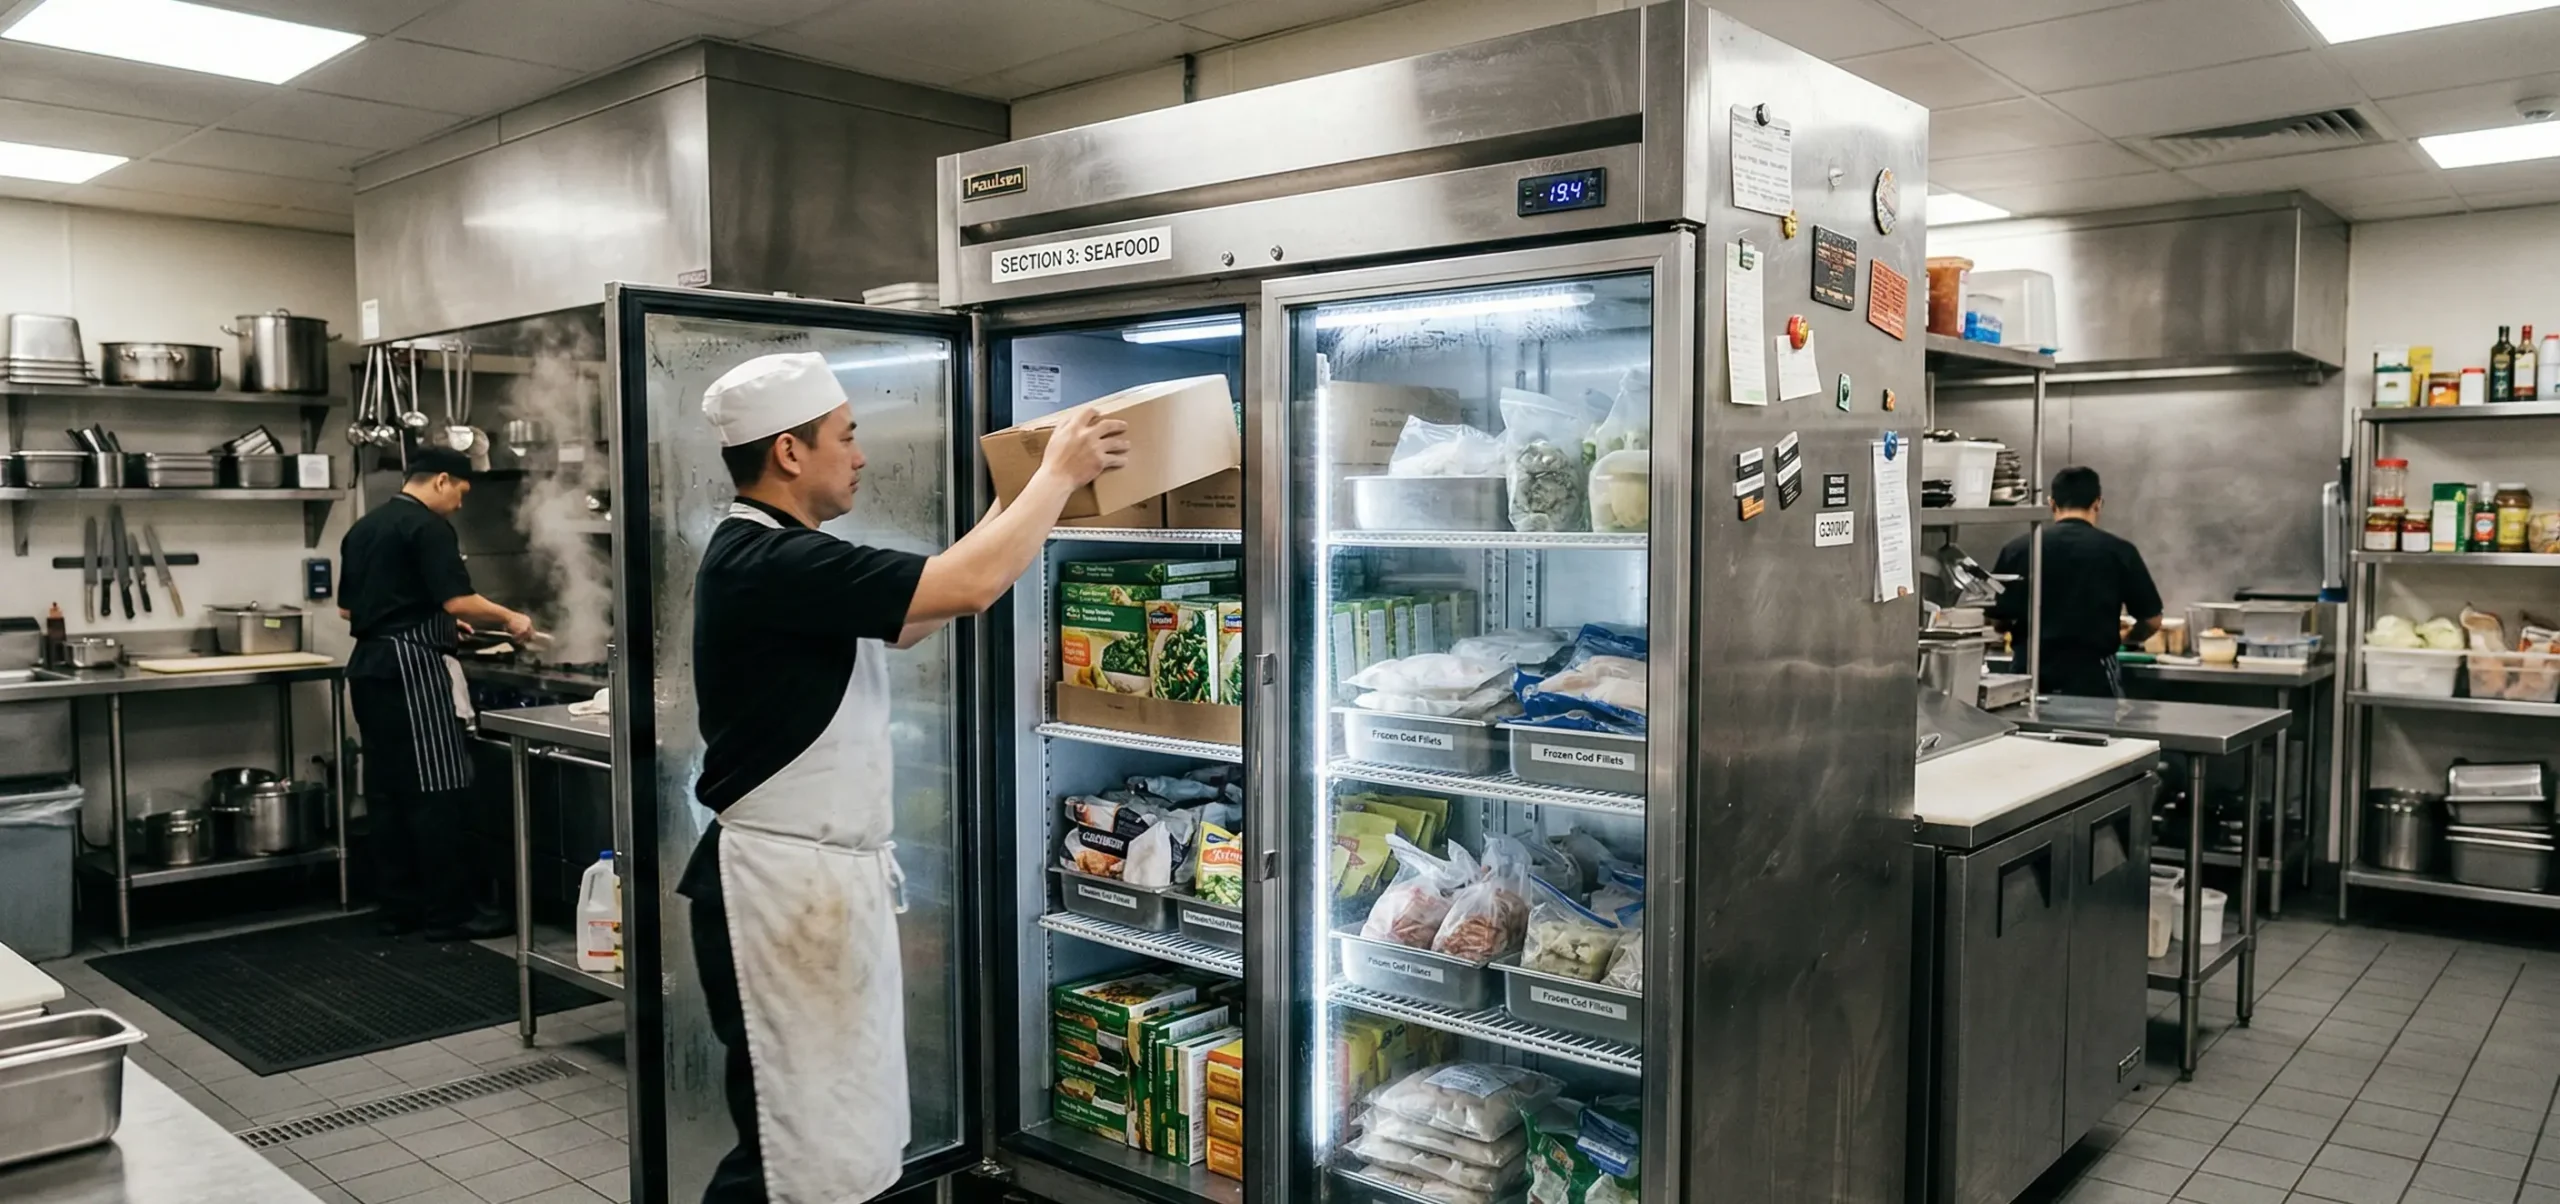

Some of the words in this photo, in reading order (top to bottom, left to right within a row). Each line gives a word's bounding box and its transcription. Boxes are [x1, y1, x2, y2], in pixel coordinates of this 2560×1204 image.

[967, 172, 1022, 195] Traulsen
[1000, 249, 1062, 274] SECTION
[1067, 248, 1080, 265] 3:
[1084, 236, 1160, 262] SEAFOOD
[1400, 733, 1417, 743] Cod
[1543, 748, 1573, 760] Frozen
[1576, 751, 1594, 762] Cod
[1596, 754, 1624, 766] Fillets
